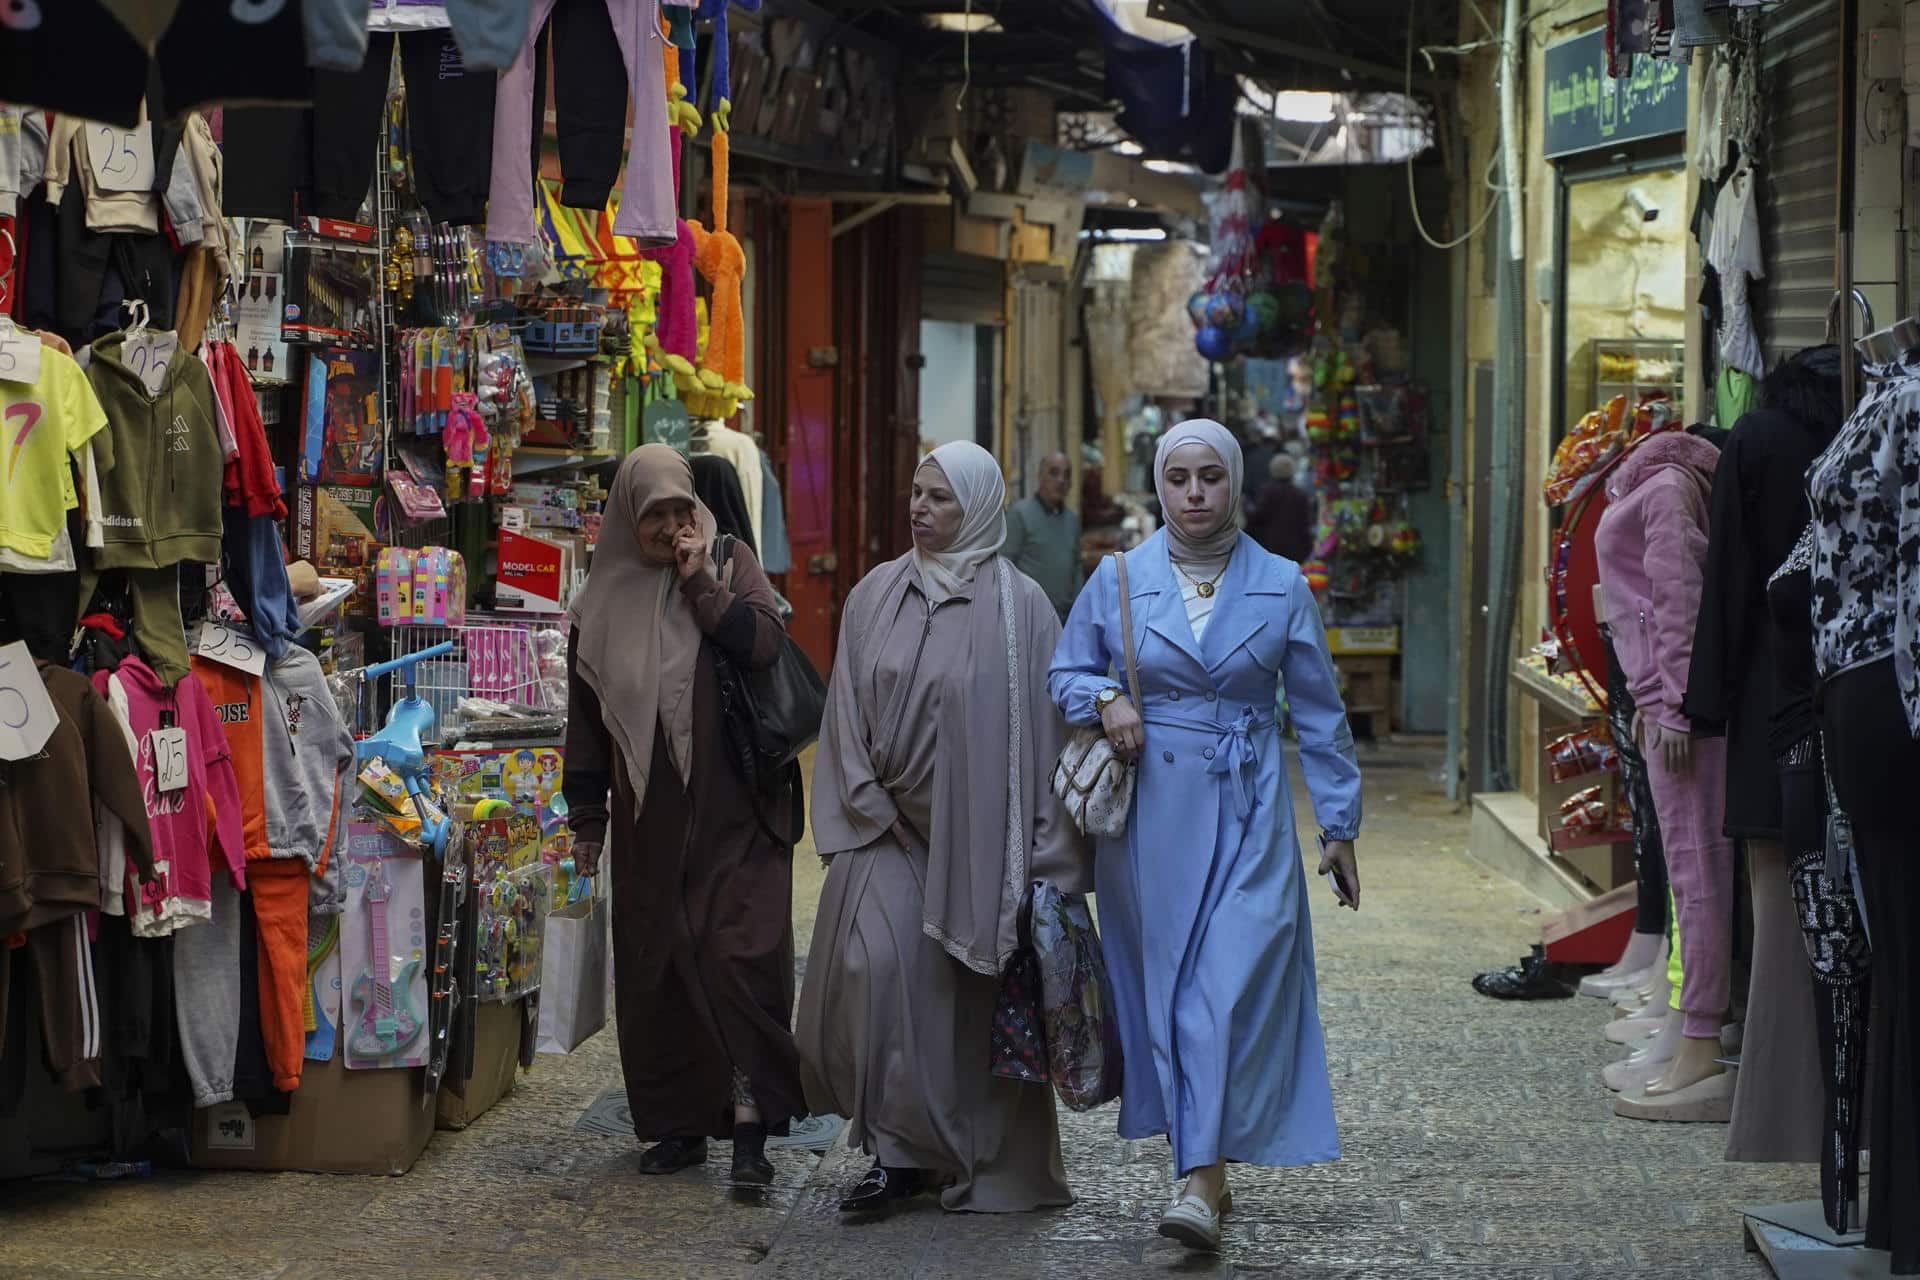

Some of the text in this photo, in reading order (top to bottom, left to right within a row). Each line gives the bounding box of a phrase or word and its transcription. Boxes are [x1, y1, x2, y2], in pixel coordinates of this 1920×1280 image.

[101, 127, 138, 184] 25
[130, 342, 169, 392] 25
[5, 402, 42, 485] 7
[502, 561, 556, 573] MODEL CAR
[201, 626, 258, 661] 25
[159, 737, 184, 783] 25
